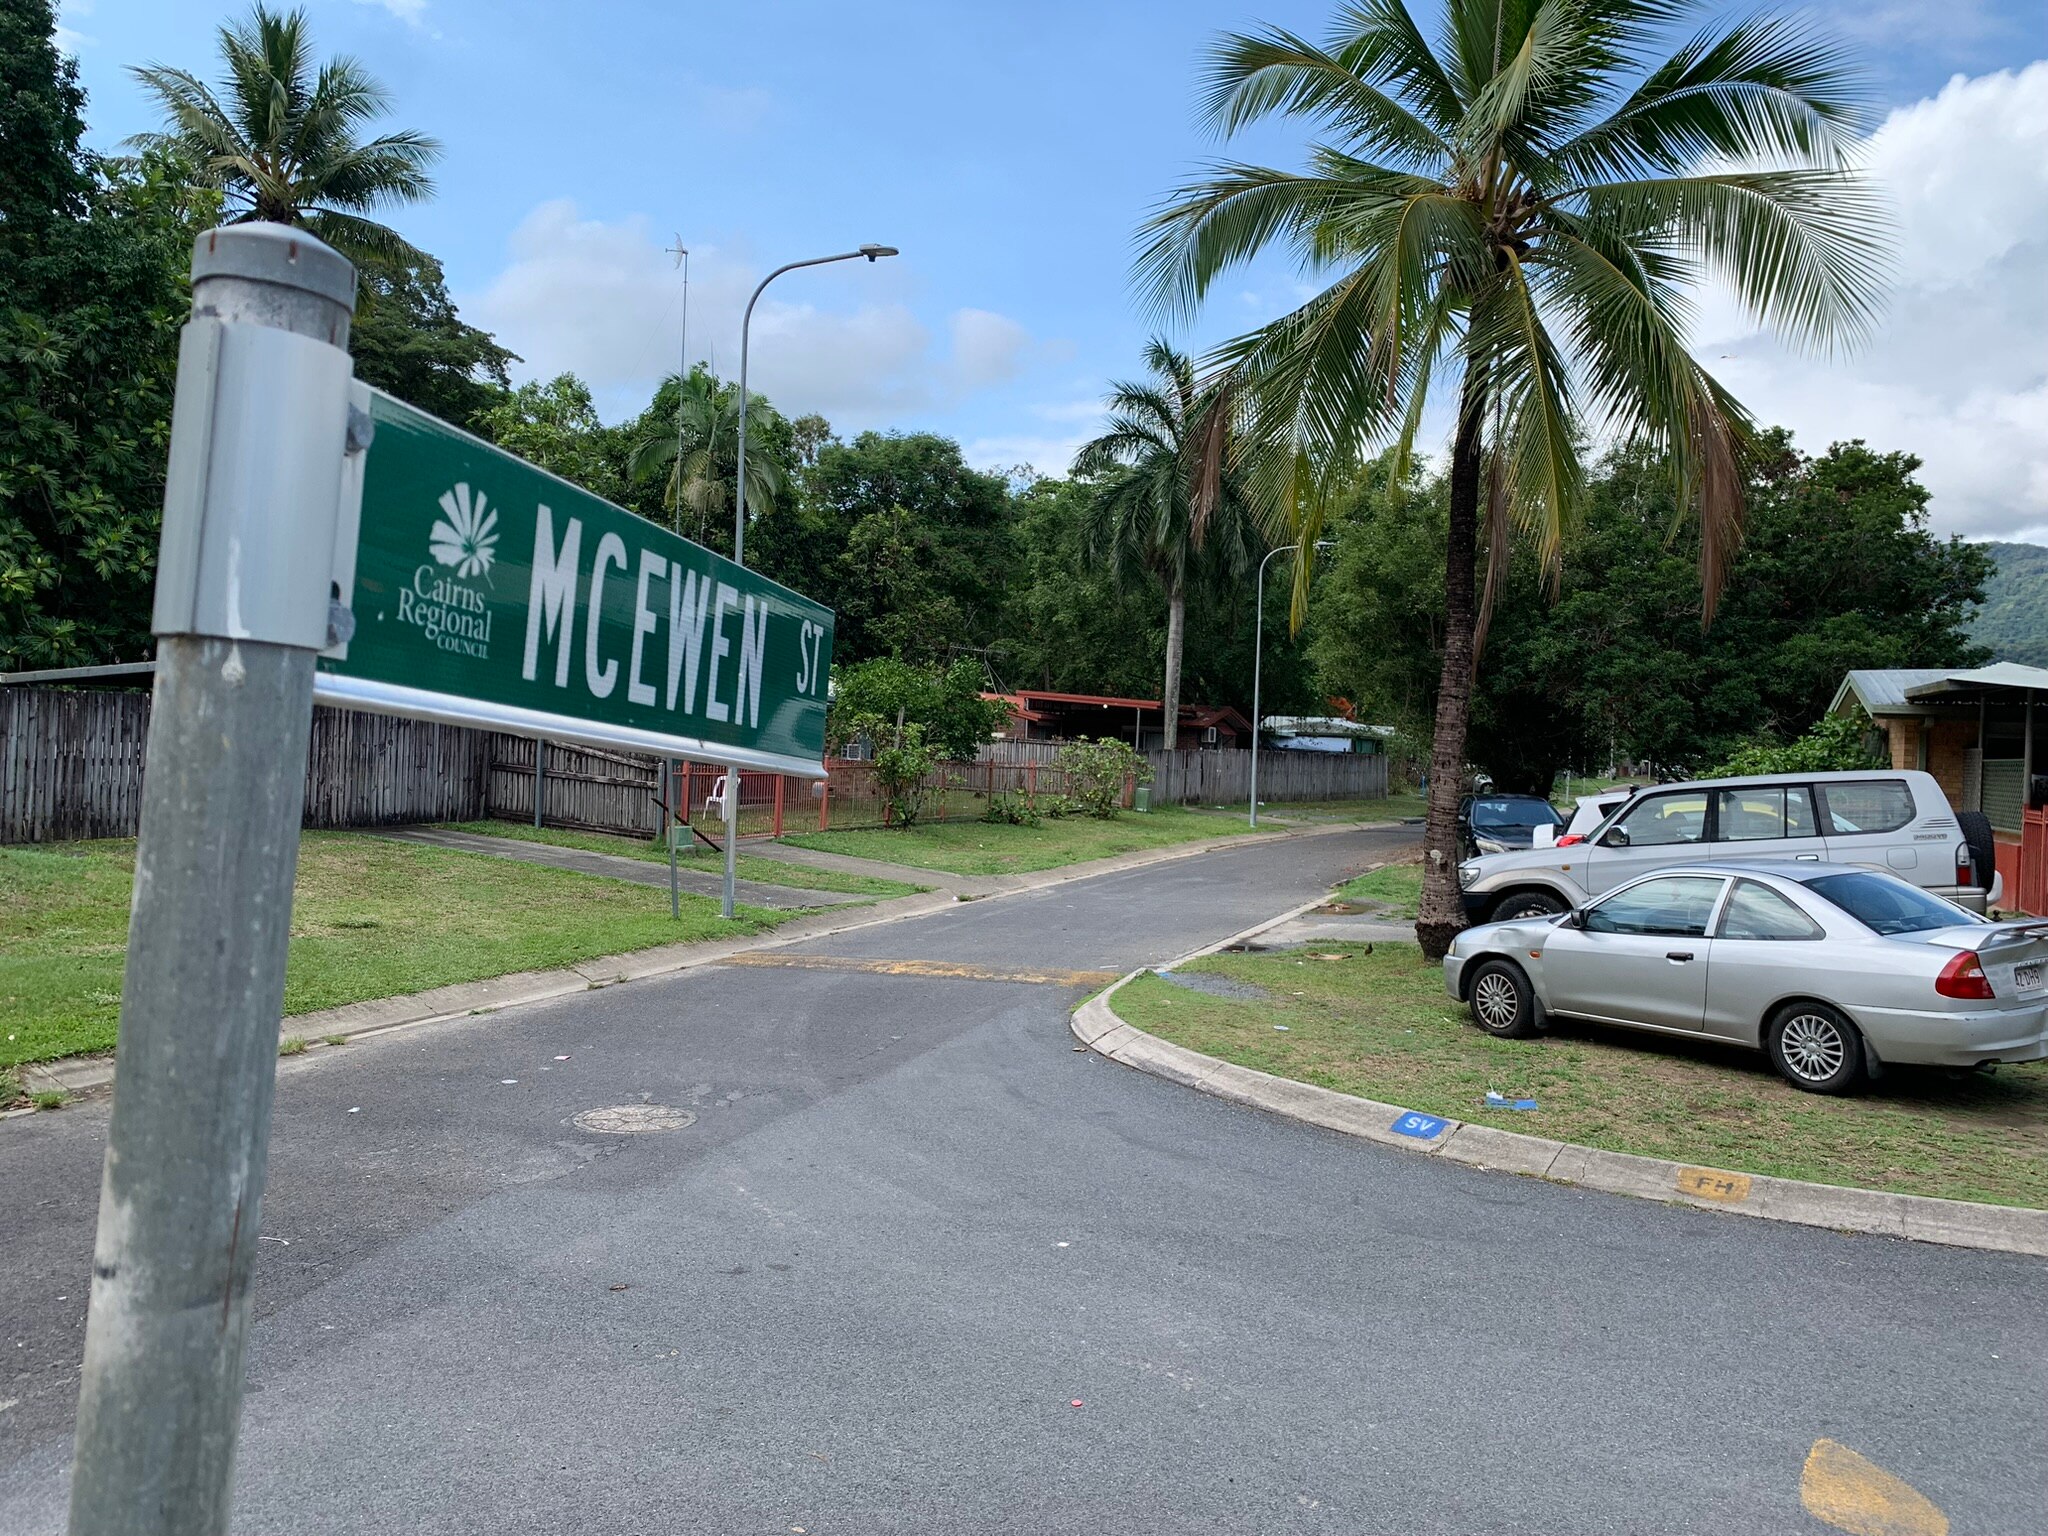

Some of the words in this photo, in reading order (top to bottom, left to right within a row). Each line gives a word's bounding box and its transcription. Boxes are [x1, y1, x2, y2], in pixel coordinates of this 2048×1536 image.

[414, 565, 485, 614] Cairns
[396, 586, 492, 642] Regional
[522, 503, 768, 729] MCEWEN
[797, 619, 824, 696] ST
[436, 634, 489, 659] COUNCIL
[1405, 1116, 1436, 1131] SV
[1697, 1177, 1734, 1195] FH
